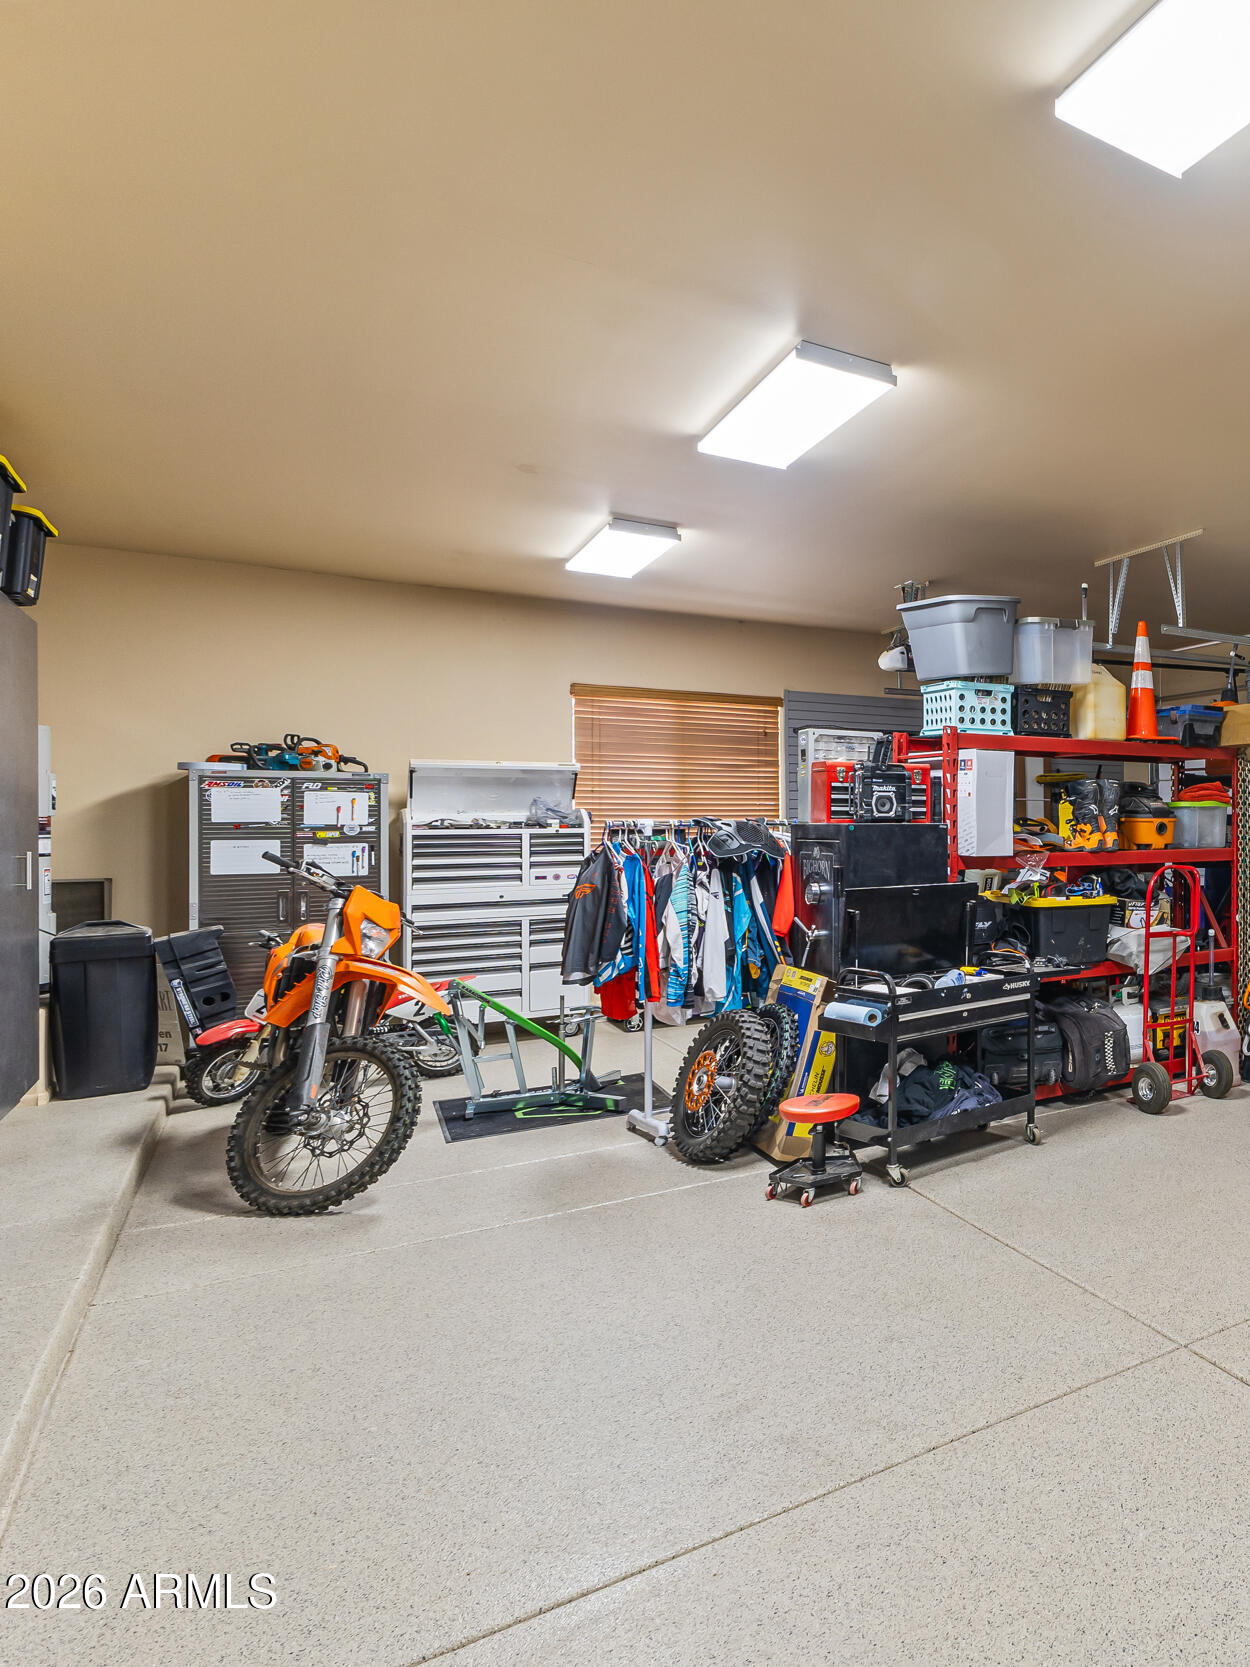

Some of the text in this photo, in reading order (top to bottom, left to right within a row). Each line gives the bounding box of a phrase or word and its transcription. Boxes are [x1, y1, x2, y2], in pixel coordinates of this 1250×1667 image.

[1010, 980, 1031, 989] HUSKY
[413, 1000, 426, 1017] 2
[158, 1031, 173, 1039] en
[157, 1043, 169, 1053] 17
